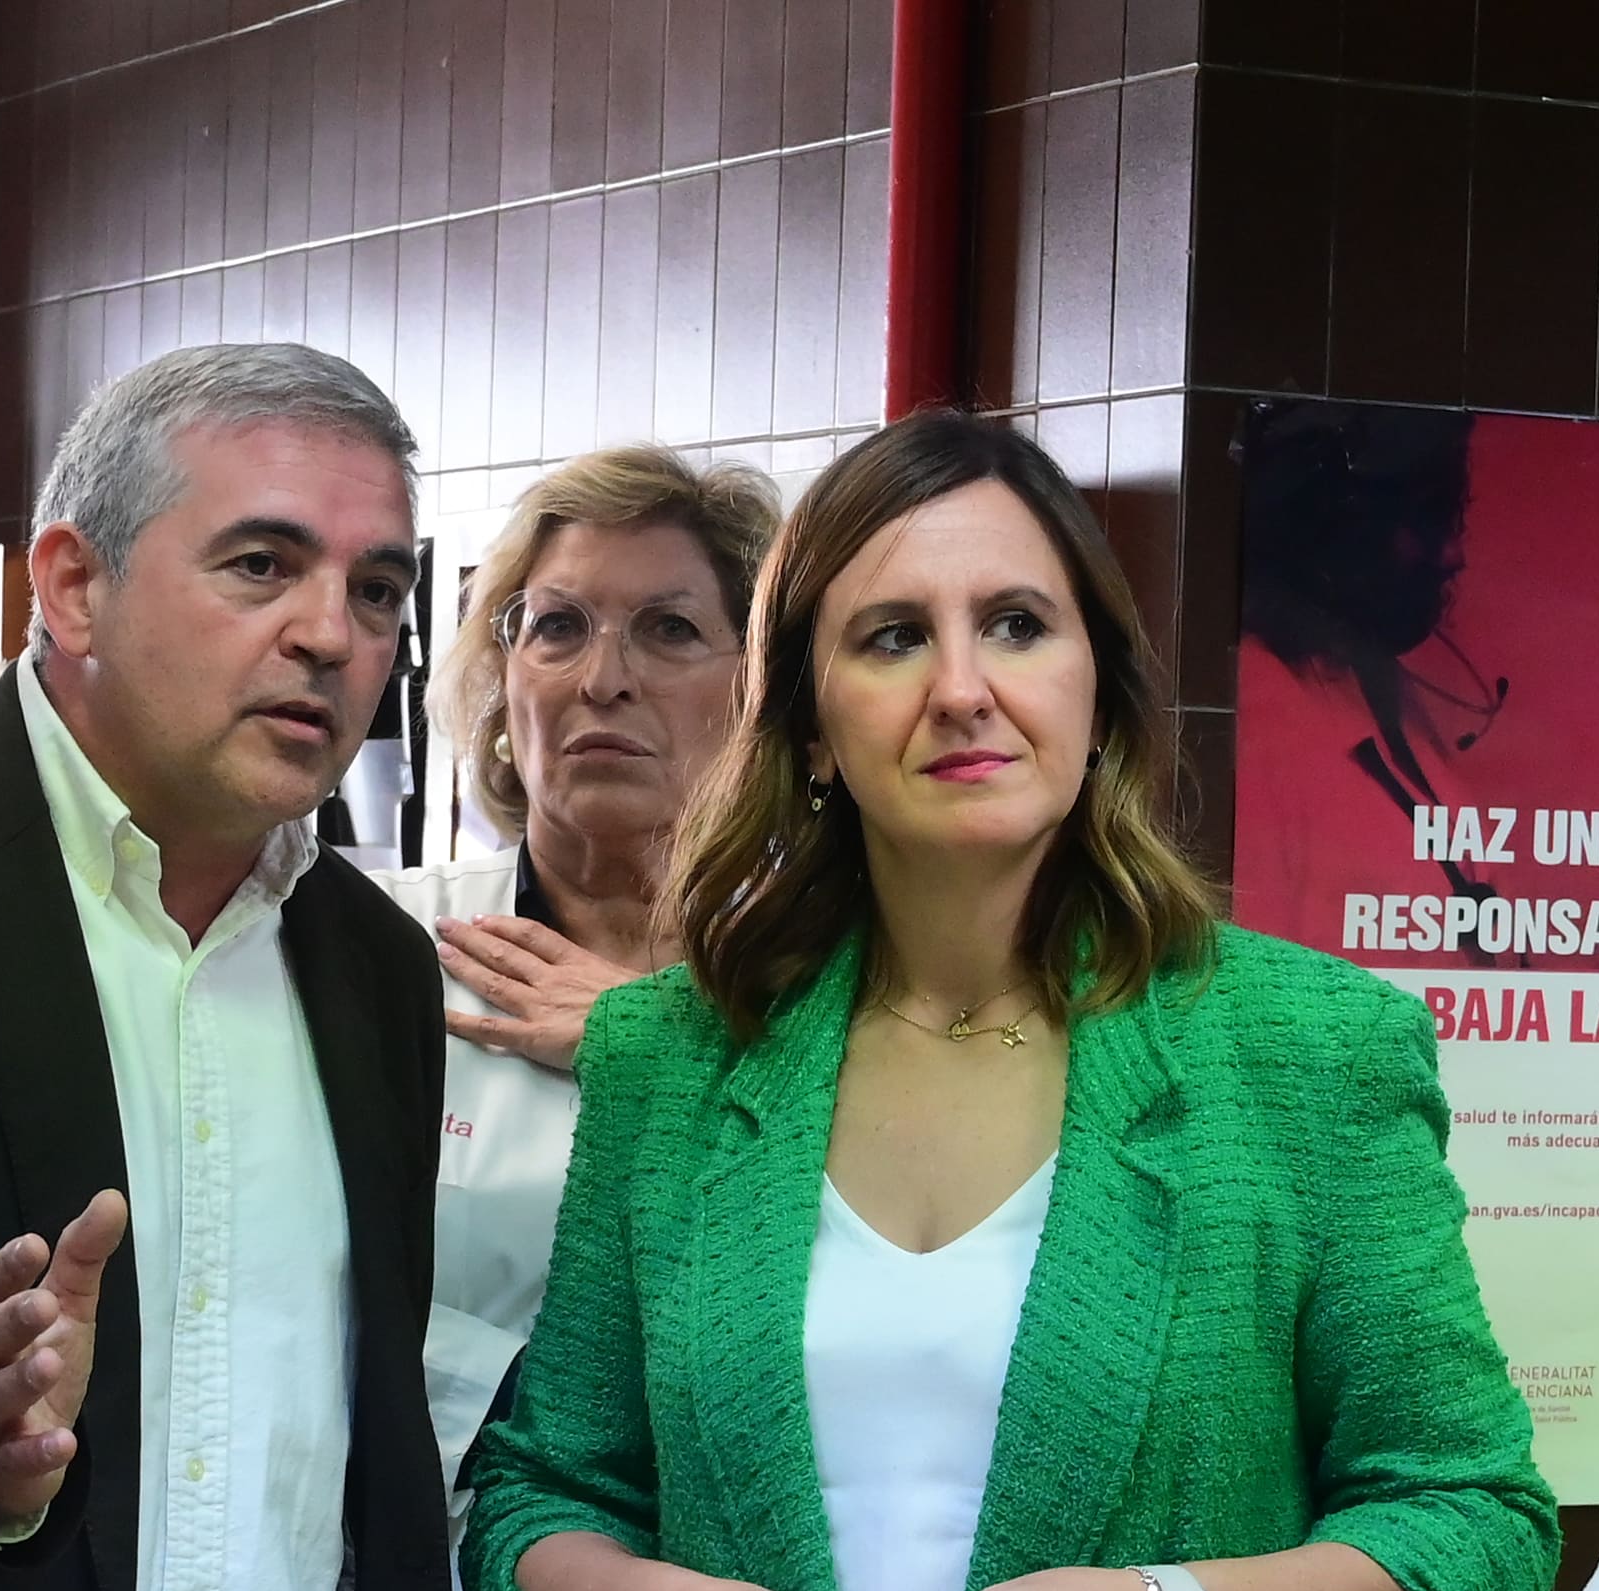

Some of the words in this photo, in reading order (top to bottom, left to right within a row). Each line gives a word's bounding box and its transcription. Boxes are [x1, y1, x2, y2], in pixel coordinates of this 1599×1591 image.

[1414, 805, 1517, 863] HAZ
[1424, 987, 1550, 1043] BAJA
[444, 1113, 473, 1138] ta
[1454, 1110, 1497, 1125] salud
[1503, 1111, 1517, 1124] te
[1507, 1133, 1540, 1148] más
[1510, 1366, 1596, 1380] ENERALITAT
